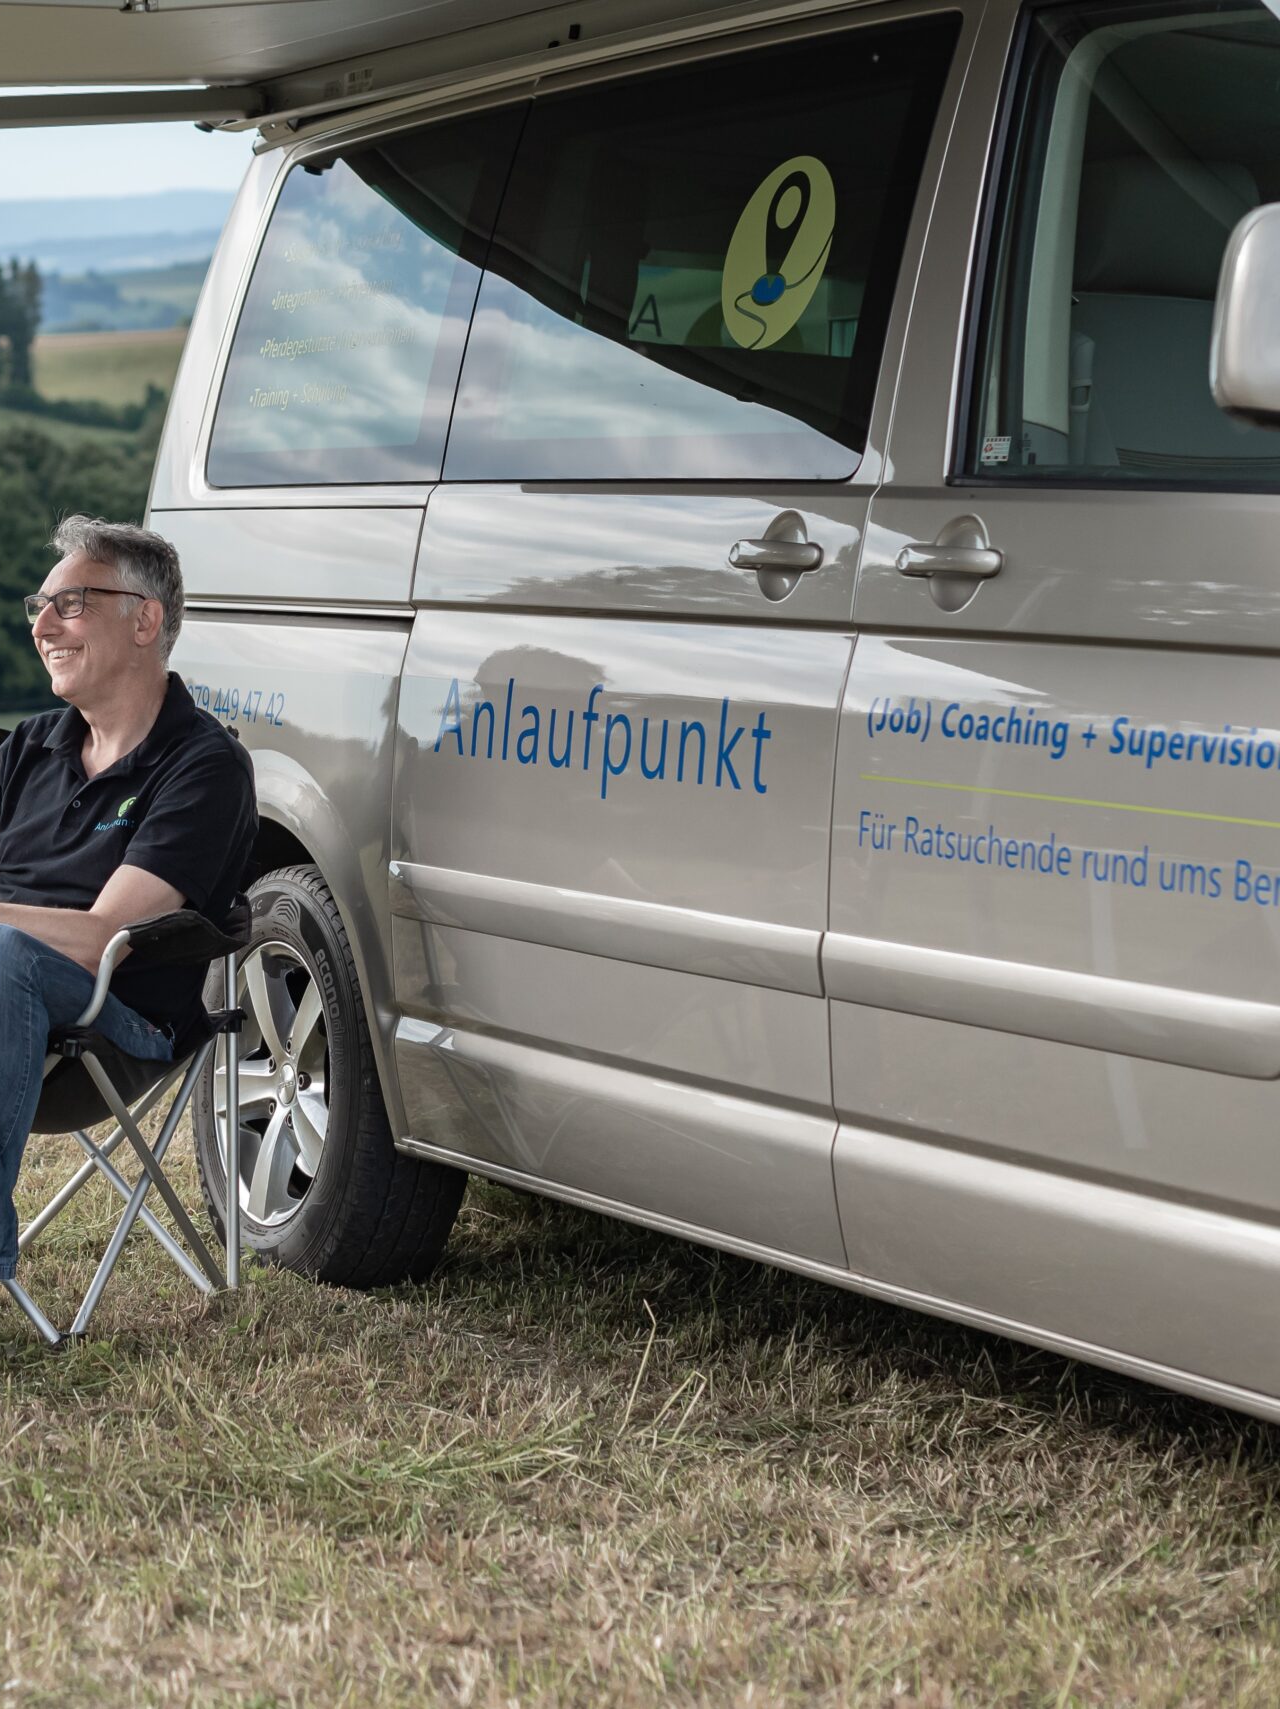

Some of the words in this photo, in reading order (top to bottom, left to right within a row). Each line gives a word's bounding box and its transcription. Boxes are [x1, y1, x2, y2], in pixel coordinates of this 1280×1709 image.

[254, 387, 289, 411] Training
[213, 687, 239, 720] 449
[242, 690, 263, 723] 47
[265, 692, 285, 726] 42
[434, 678, 771, 799] Anlaufpunkt
[868, 698, 931, 742] (Job)
[941, 703, 1069, 759] Coaching
[1081, 724, 1097, 748] +
[1109, 716, 1280, 771] Supervisio
[859, 811, 896, 850] Für
[904, 816, 1071, 875] Ratsuchende
[1082, 845, 1148, 887] rund
[1160, 861, 1222, 898] ums
